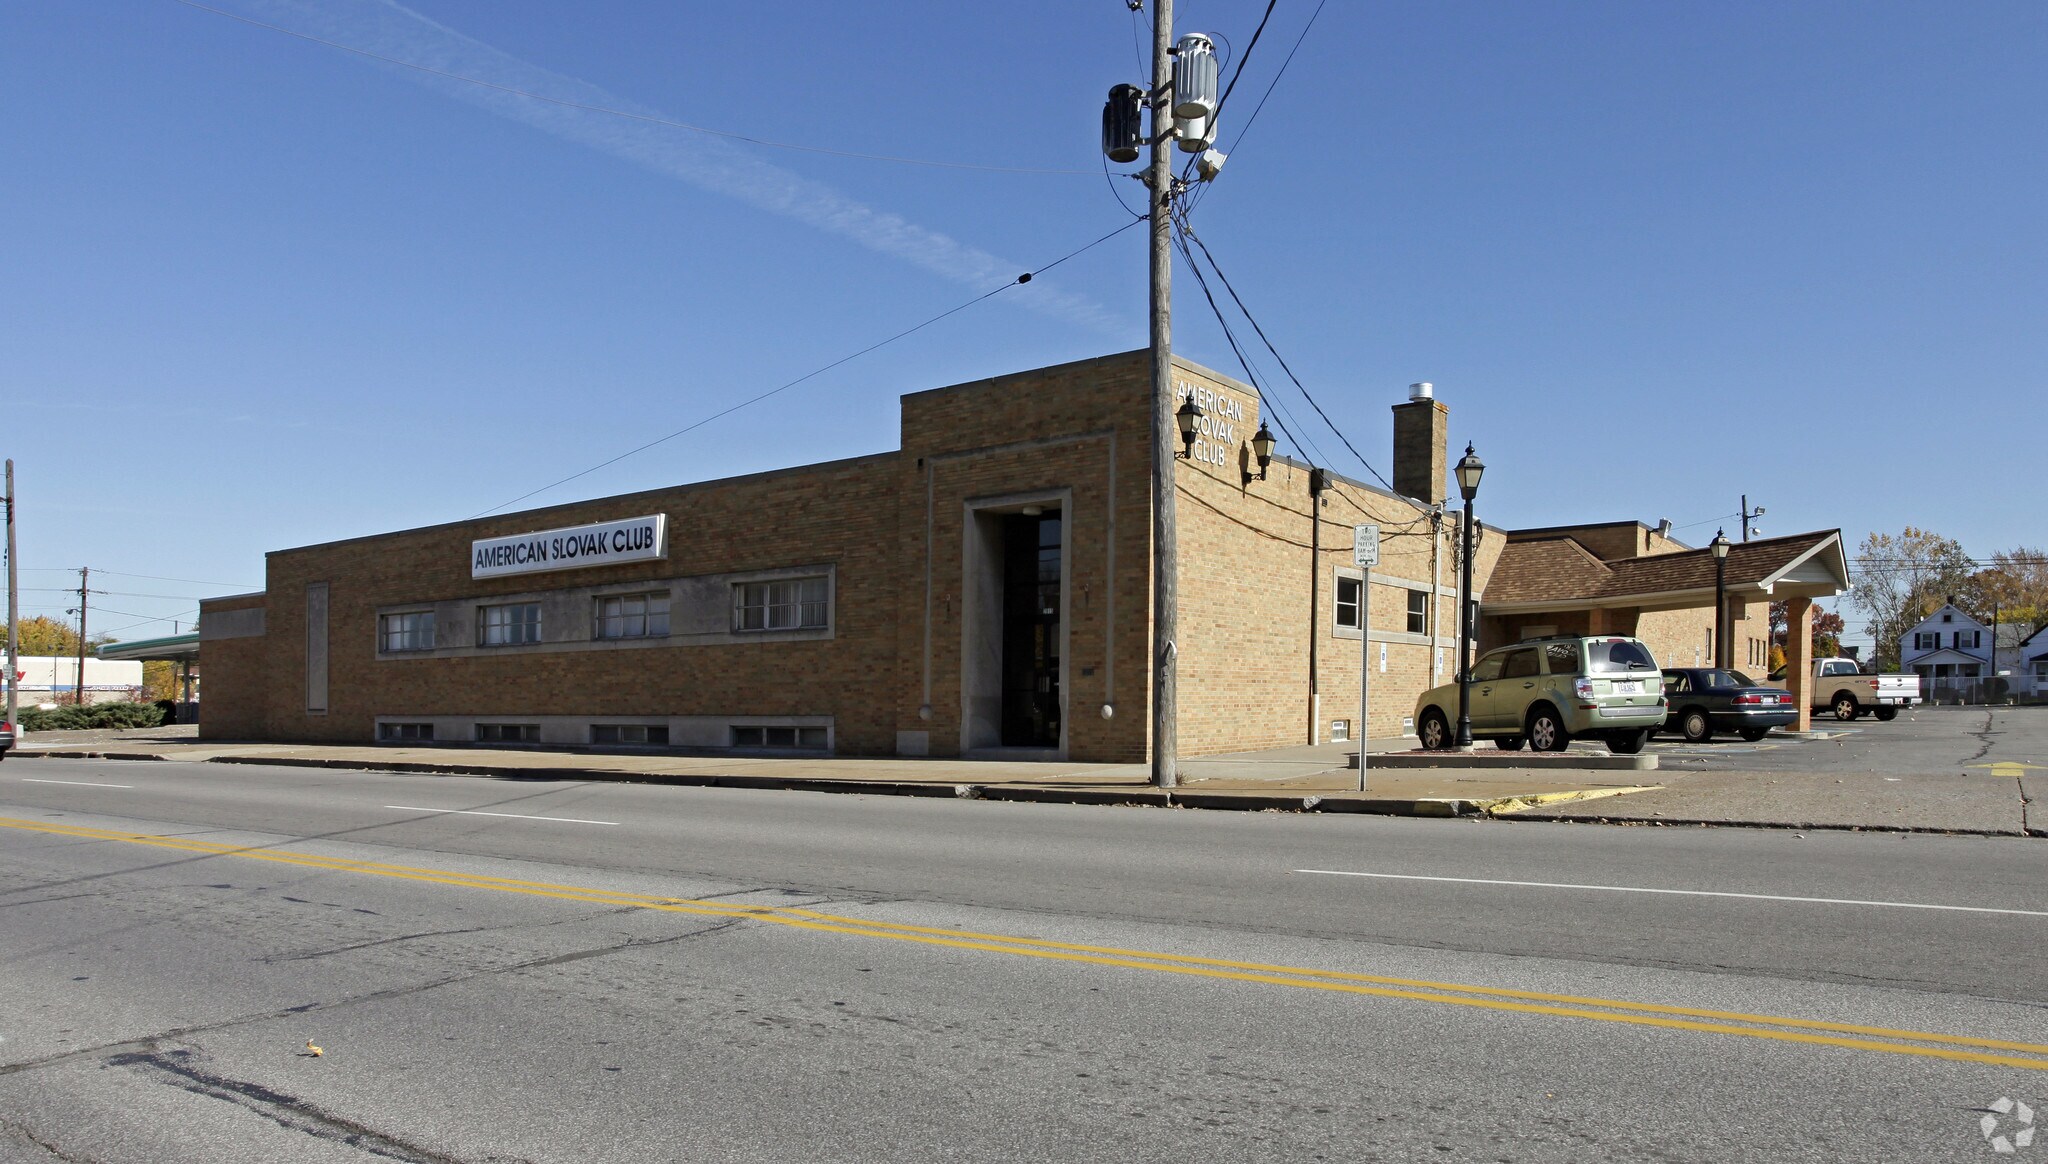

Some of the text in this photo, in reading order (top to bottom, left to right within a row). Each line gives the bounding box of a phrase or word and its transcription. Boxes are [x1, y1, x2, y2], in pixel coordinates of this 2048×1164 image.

[1176, 380, 1242, 422] AMERICAN
[1194, 414, 1234, 445] OVAK
[1194, 439, 1225, 466] CLUB
[475, 526, 654, 569] AMERICAN SLOVAK CLUB
